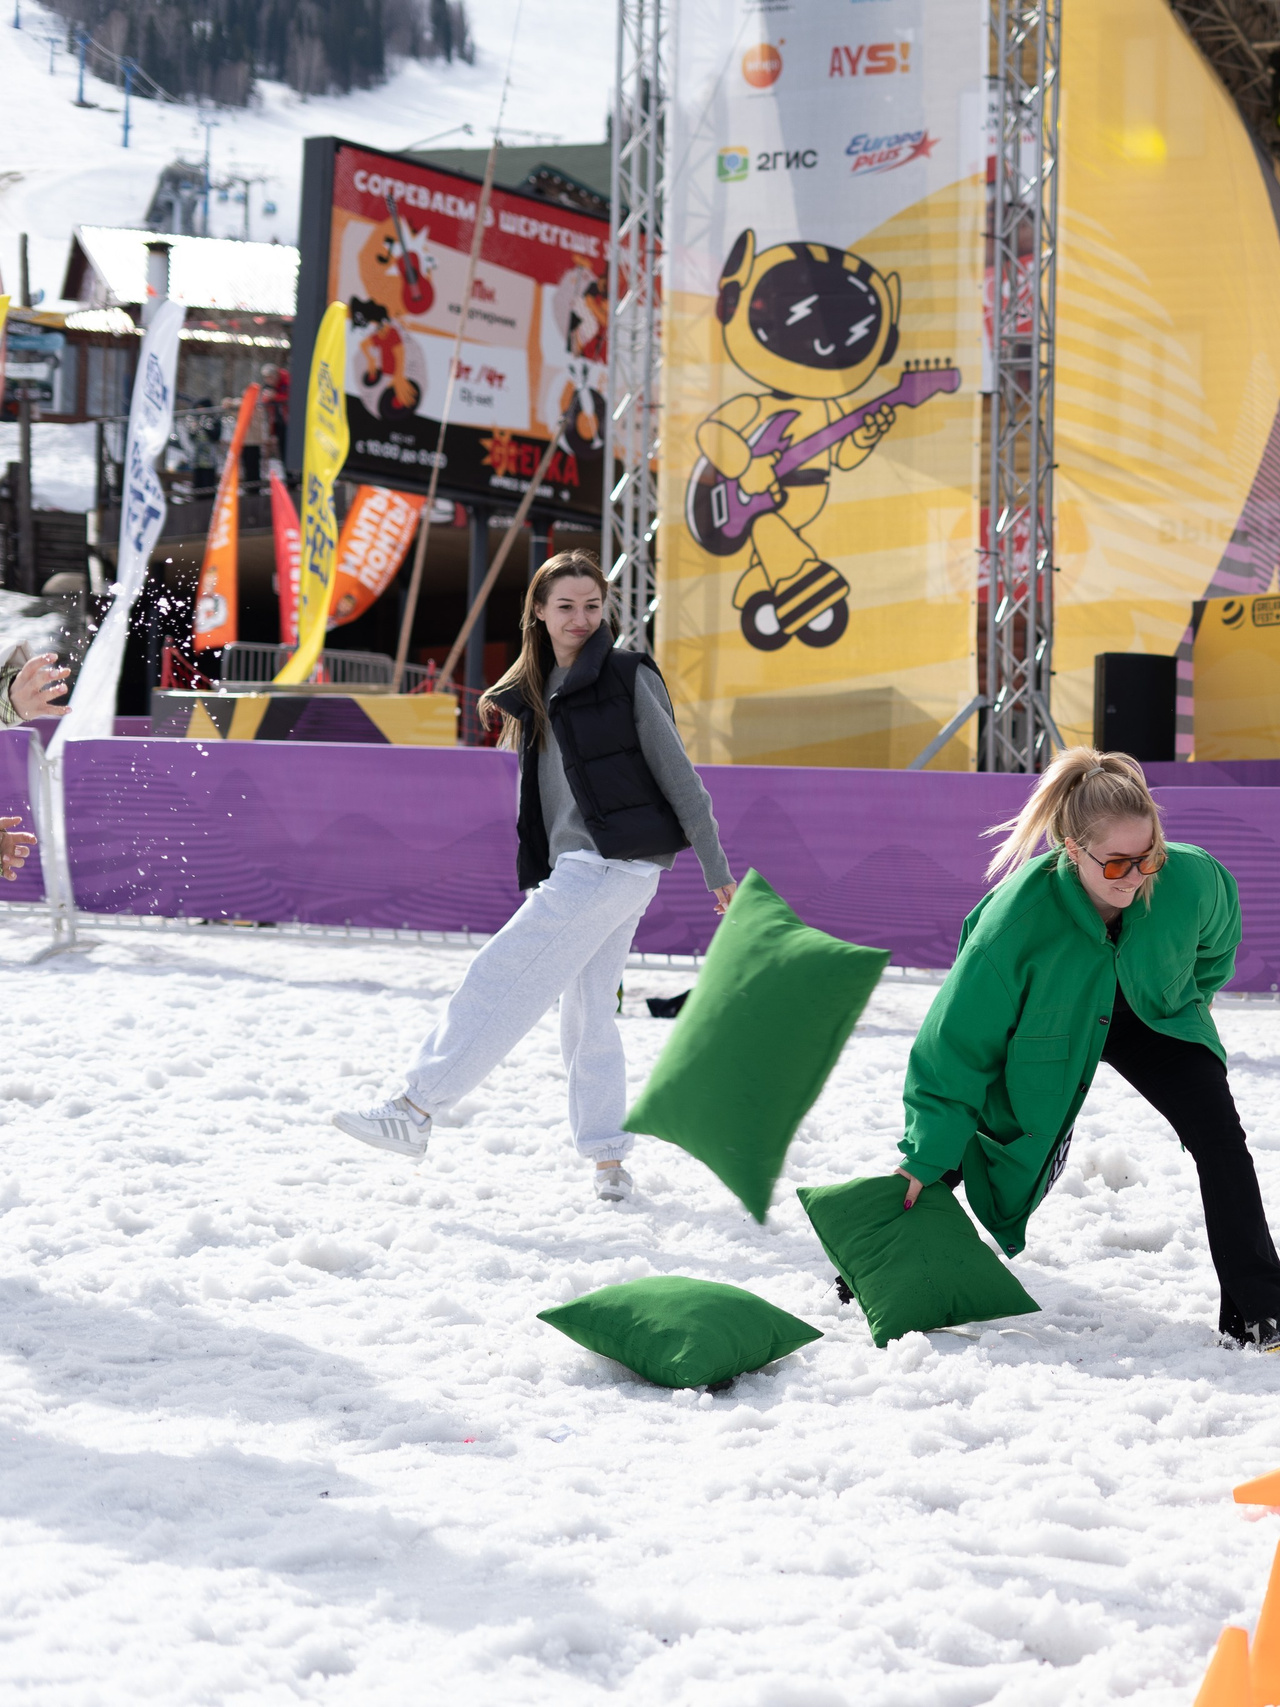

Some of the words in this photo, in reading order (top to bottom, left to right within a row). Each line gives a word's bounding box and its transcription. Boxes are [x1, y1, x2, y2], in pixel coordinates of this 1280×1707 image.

[829, 42, 911, 78] AYS!
[756, 150, 819, 172] 2ГИС
[353, 168, 477, 223] СОГРЕВАЕМ
[499, 210, 601, 257] ШЕРЕГЕШЕ
[337, 484, 392, 577] МАНТЫ
[358, 494, 410, 591] ПОНТЫ
